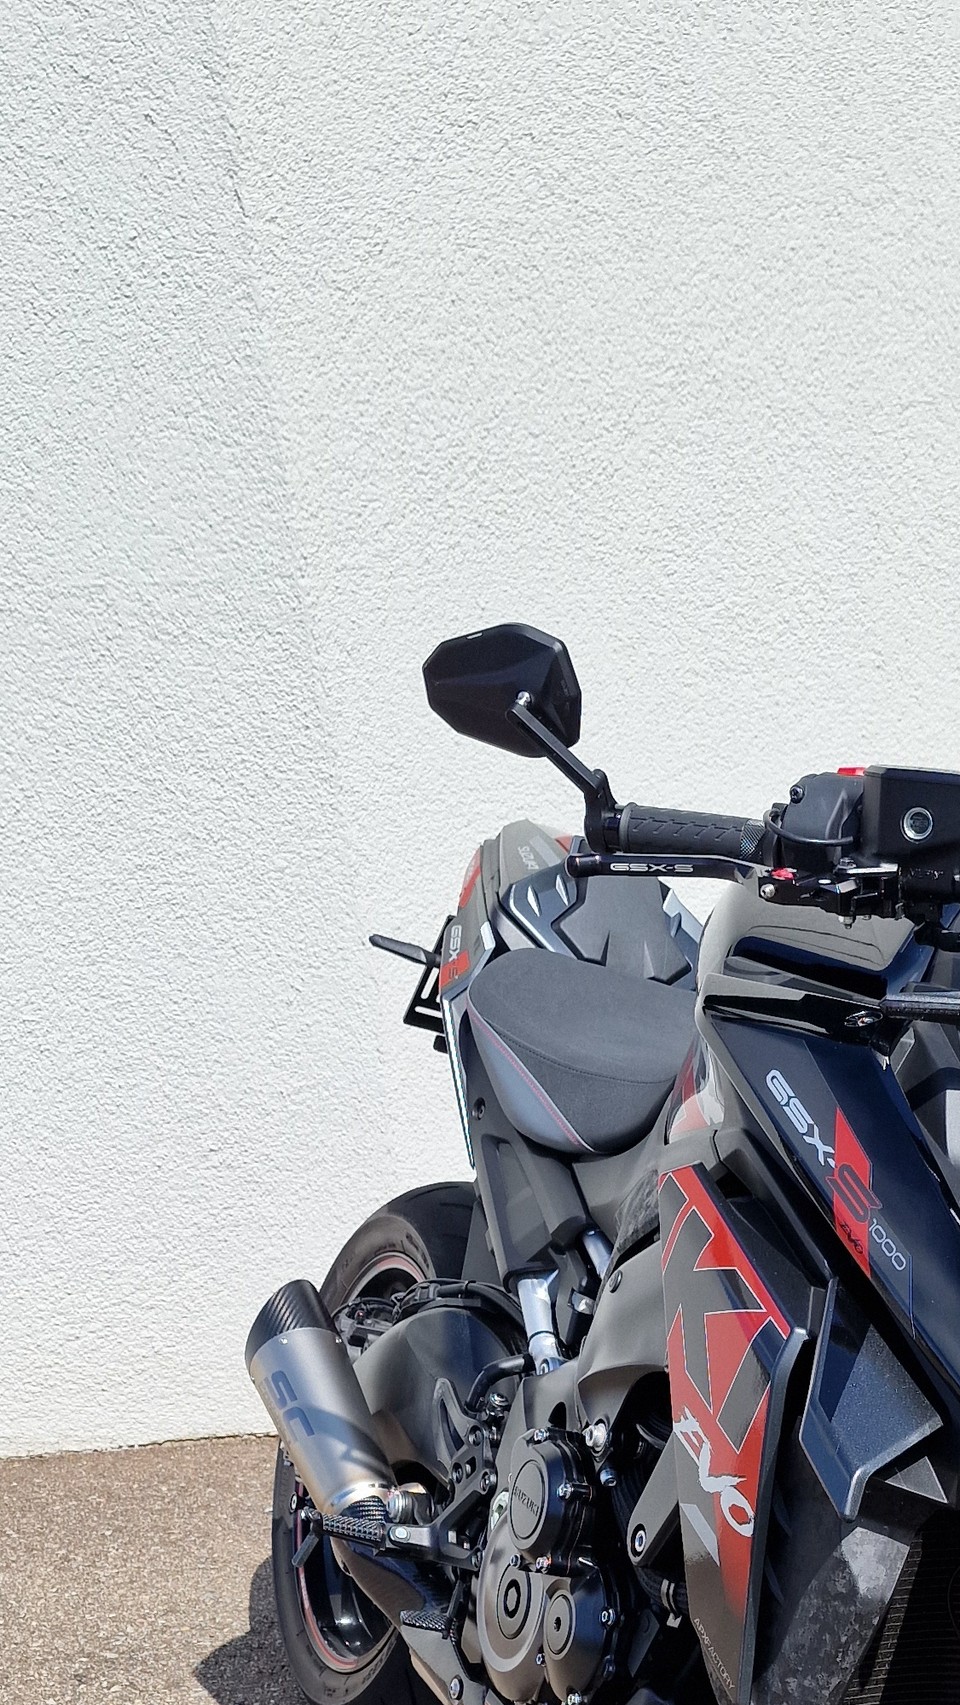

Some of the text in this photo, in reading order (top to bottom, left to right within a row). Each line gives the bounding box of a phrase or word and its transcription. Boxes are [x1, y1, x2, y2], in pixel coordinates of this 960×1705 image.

[609, 863, 694, 873] GSX-S
[869, 1218, 907, 1271] 1000
[263, 1370, 315, 1443] SC
[673, 1405, 754, 1537] EVO
[513, 1485, 540, 1517] SUZUKI
